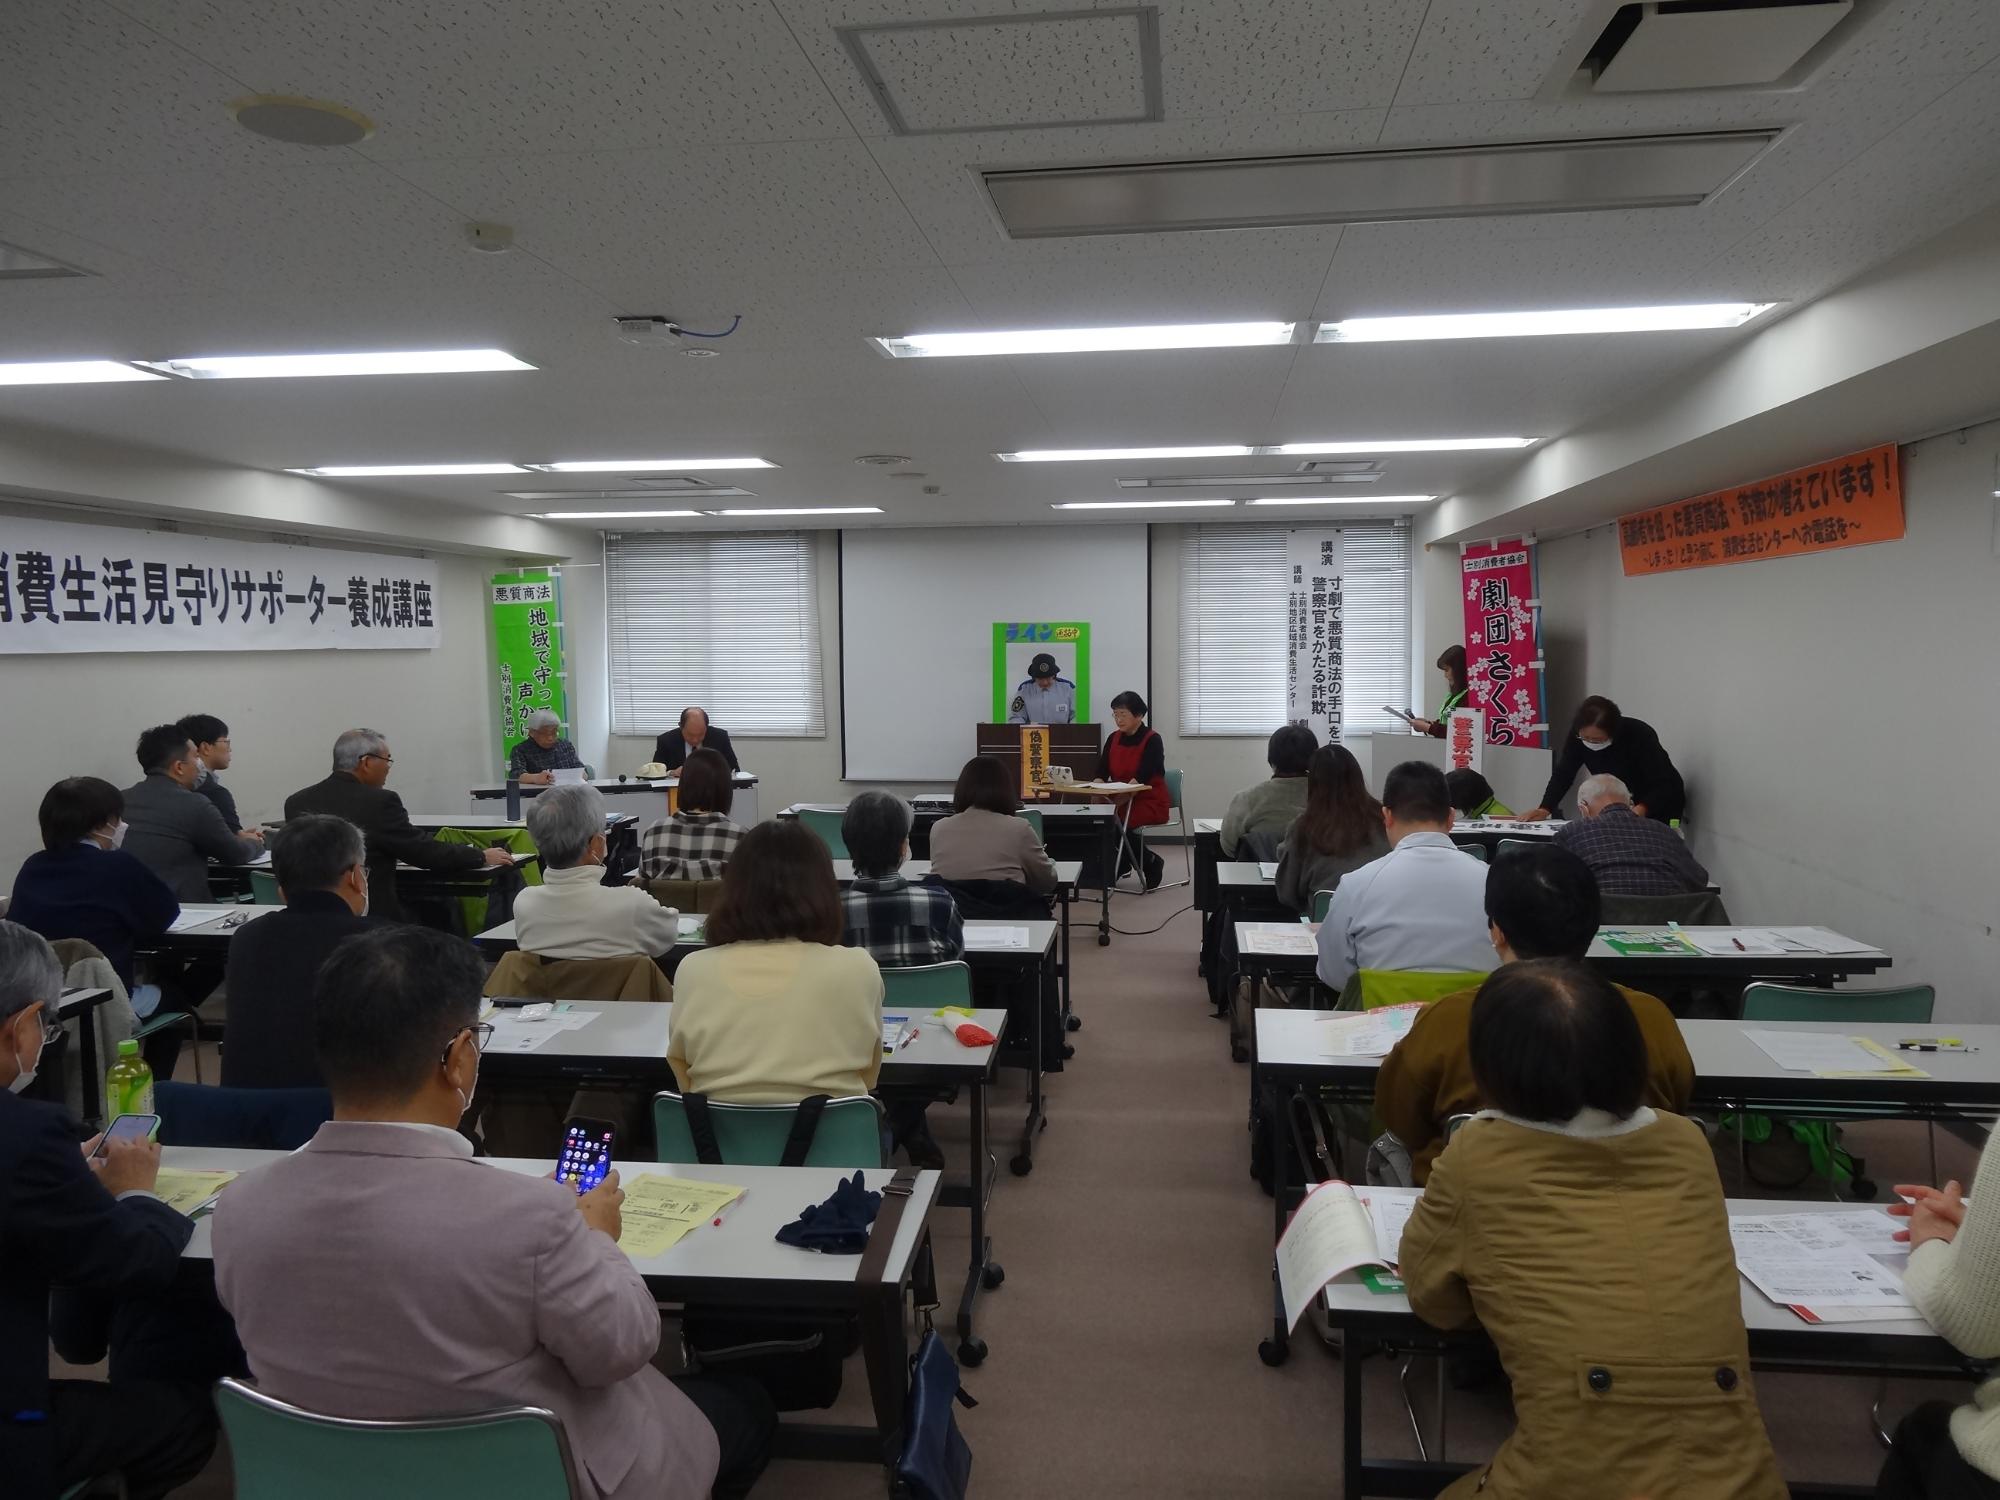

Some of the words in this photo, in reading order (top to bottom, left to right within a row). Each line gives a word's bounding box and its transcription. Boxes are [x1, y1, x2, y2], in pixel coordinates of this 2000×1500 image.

[0, 551, 433, 628] 費生活見守りサポーター養成講座
[1293, 565, 1302, 584] 講師
[1321, 541, 1333, 566] 講演
[1465, 554, 1525, 570] 士別消費者協会
[495, 585, 550, 601] 悪質商法
[1299, 591, 1307, 650] 士別消費者協会
[529, 608, 551, 710] 地域で守っ
[1289, 591, 1298, 708] 士別地区広域消費生活センター
[1311, 576, 1327, 715] 警察官をかたる詐欺
[1481, 576, 1515, 746] 劇団さくら
[501, 663, 514, 737] 士別消費者協会
